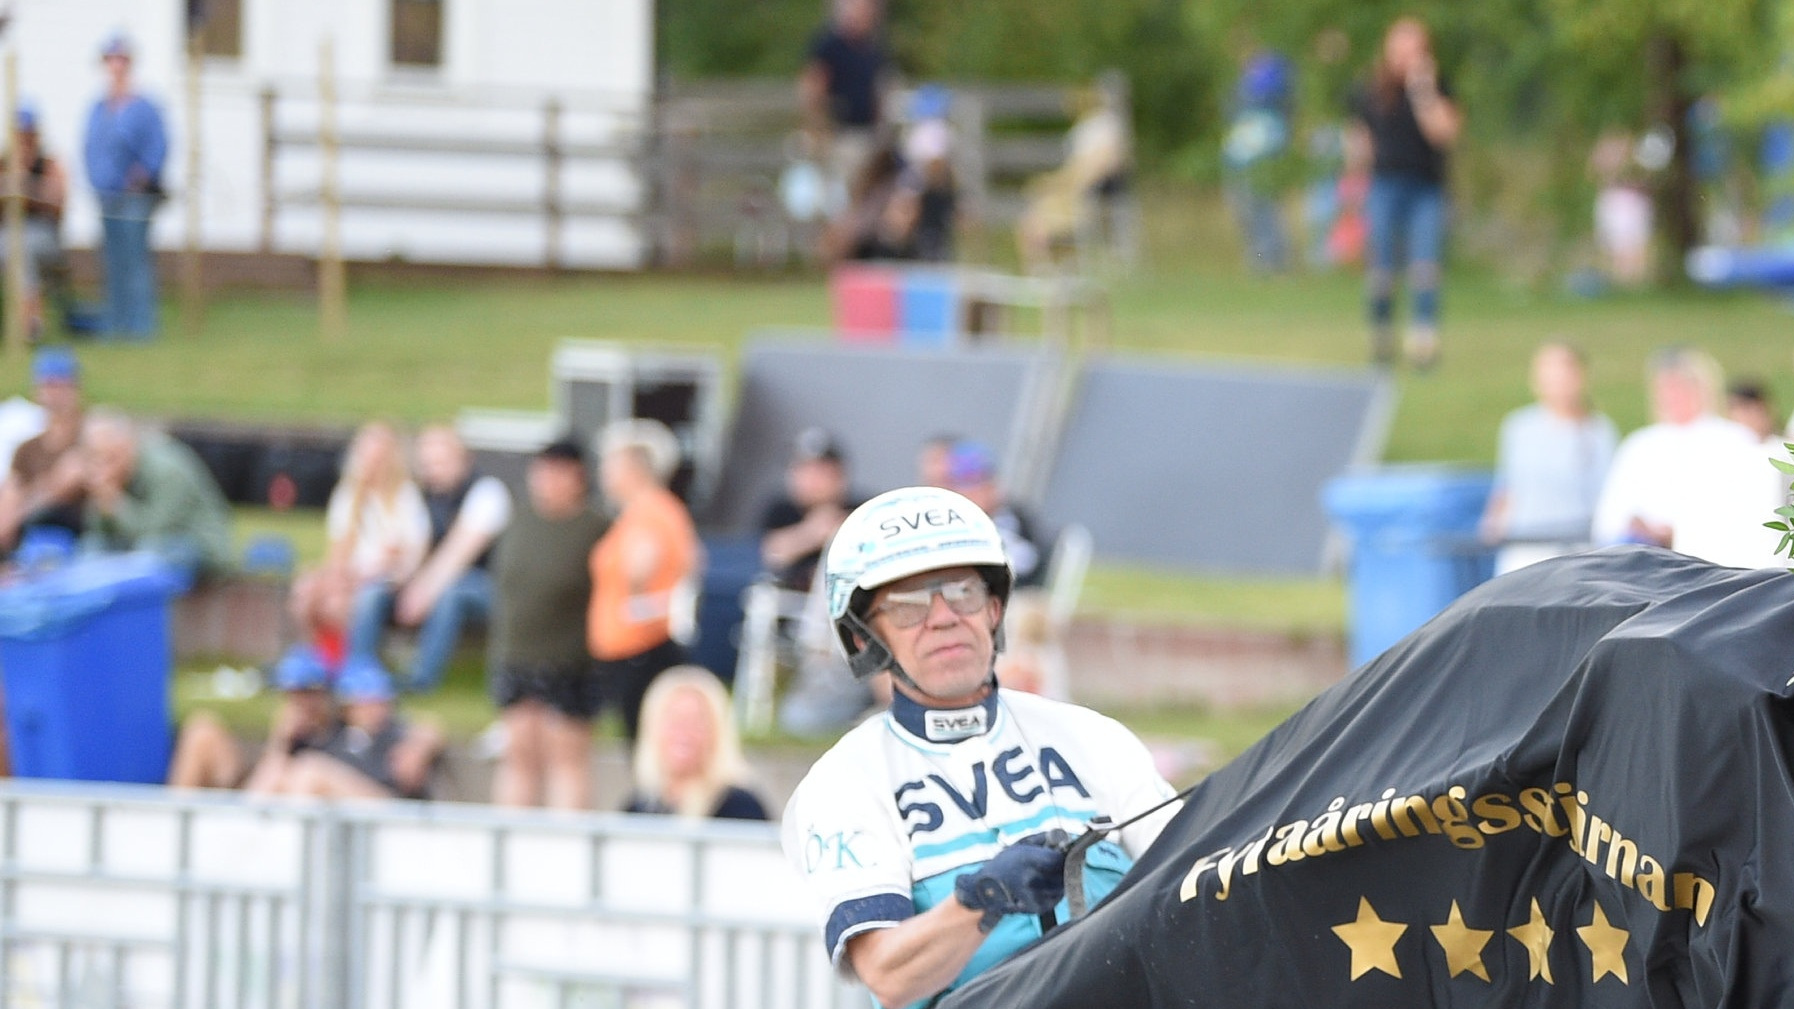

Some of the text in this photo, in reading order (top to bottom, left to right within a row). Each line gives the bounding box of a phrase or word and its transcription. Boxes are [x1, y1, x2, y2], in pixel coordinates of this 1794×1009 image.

[880, 508, 966, 539] SVEA
[932, 714, 981, 729] SVEA
[895, 746, 1091, 833] SVEA
[1179, 782, 1715, 927] Fyraåringsstjrnan
